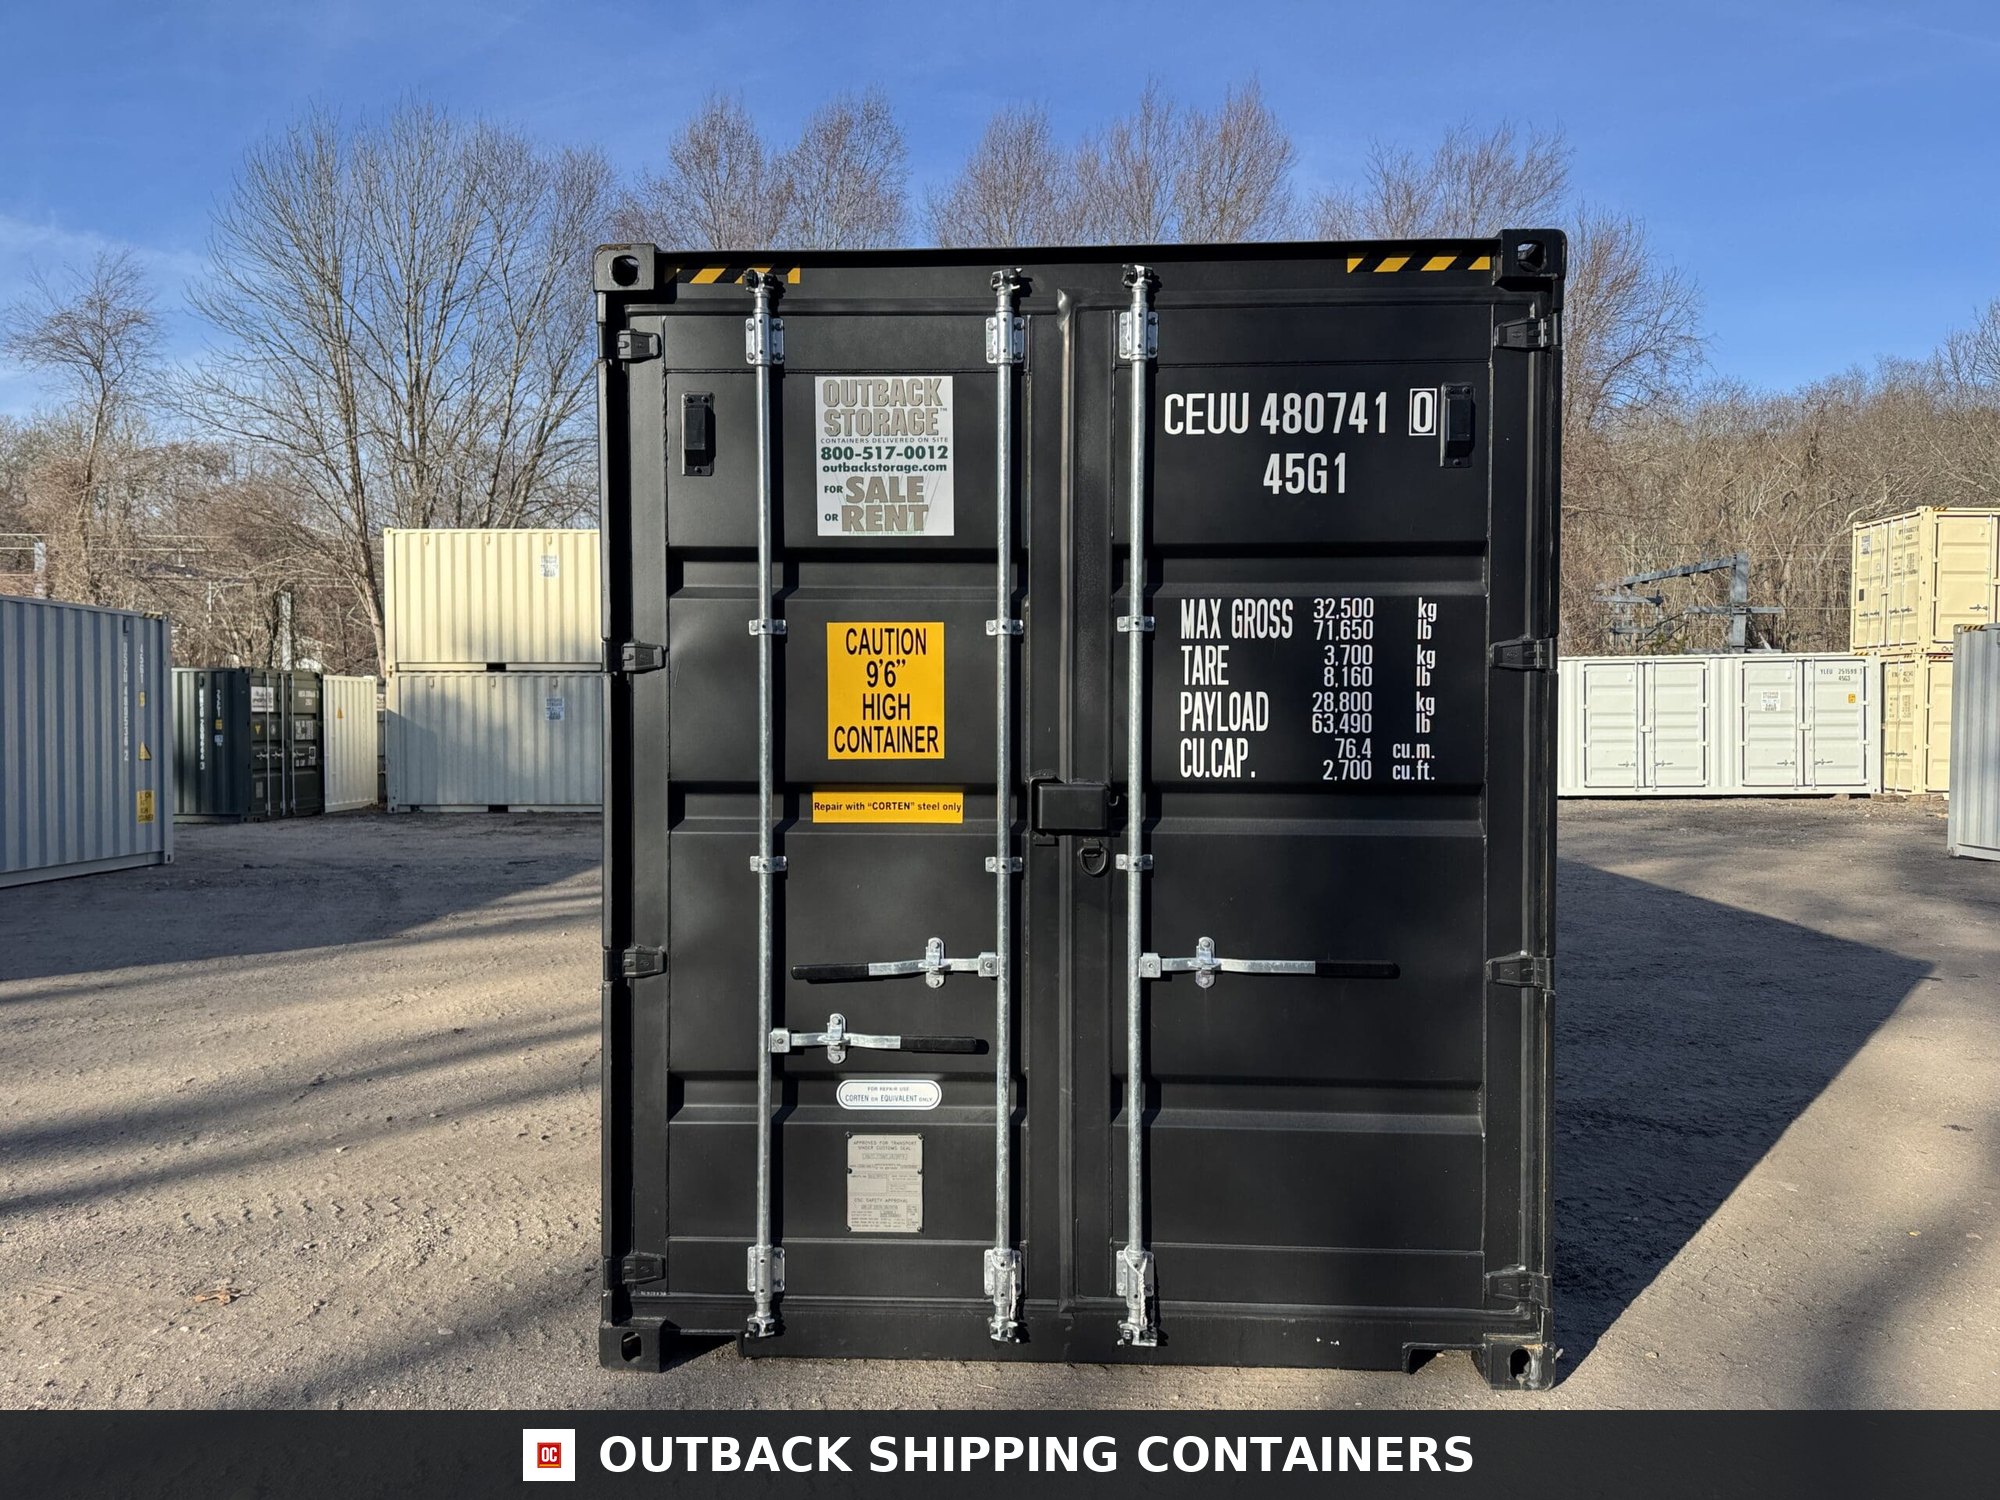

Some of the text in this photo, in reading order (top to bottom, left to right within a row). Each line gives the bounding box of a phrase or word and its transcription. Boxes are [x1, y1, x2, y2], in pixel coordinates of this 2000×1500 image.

[822, 378, 943, 407] OUTBACK
[824, 408, 939, 436] STORAGE
[1164, 391, 1433, 435] CEUU 480741 0
[821, 446, 948, 460] 800-517-0012
[823, 462, 947, 473] outbackstorage.com
[1263, 452, 1346, 494] 45G1
[846, 476, 924, 503] SALE
[842, 505, 929, 532] RENT
[1180, 597, 1437, 639] MAX GROSS 32,500 kg
[1313, 619, 1432, 641] 71,650 lb
[846, 628, 926, 655] CAUTION
[1181, 644, 1435, 685] TARE 3,700 kg
[1323, 666, 1430, 688] 8,160 lb
[863, 693, 910, 720] HIGH
[1180, 691, 1435, 732] PAYLOAD 28,800 kg
[1312, 713, 1430, 734] 63,490 lb
[834, 726, 939, 753] CONTAINER
[1335, 738, 1372, 759] 76.4
[1392, 742, 1435, 759] cu.m.
[1322, 760, 1435, 781] 2,700 cu.ft.
[814, 802, 843, 812] Repair
[845, 802, 865, 810] with
[918, 802, 940, 810] steel
[943, 802, 961, 813] only
